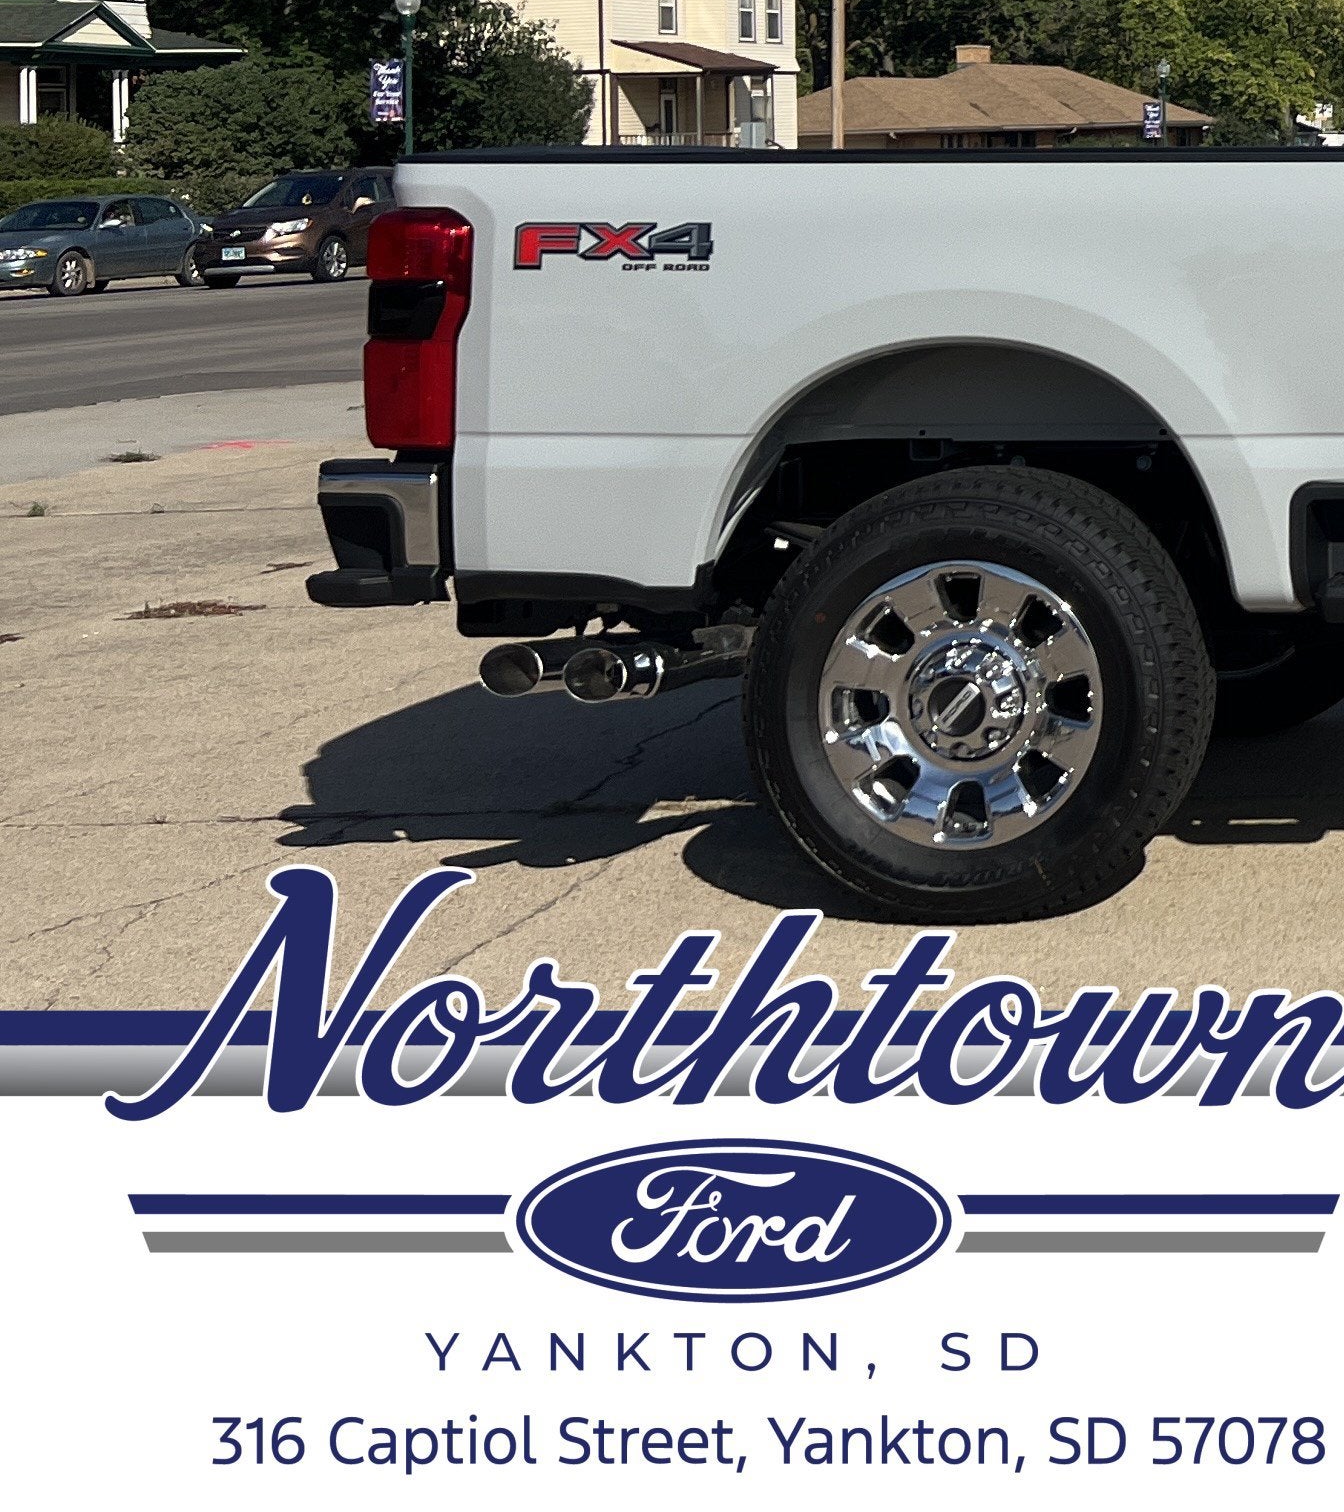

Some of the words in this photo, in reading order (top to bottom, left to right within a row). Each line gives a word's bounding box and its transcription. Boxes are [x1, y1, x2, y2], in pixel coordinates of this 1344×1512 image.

[513, 222, 714, 270] FX4
[621, 263, 658, 271] OFF
[663, 263, 711, 271] ROAD
